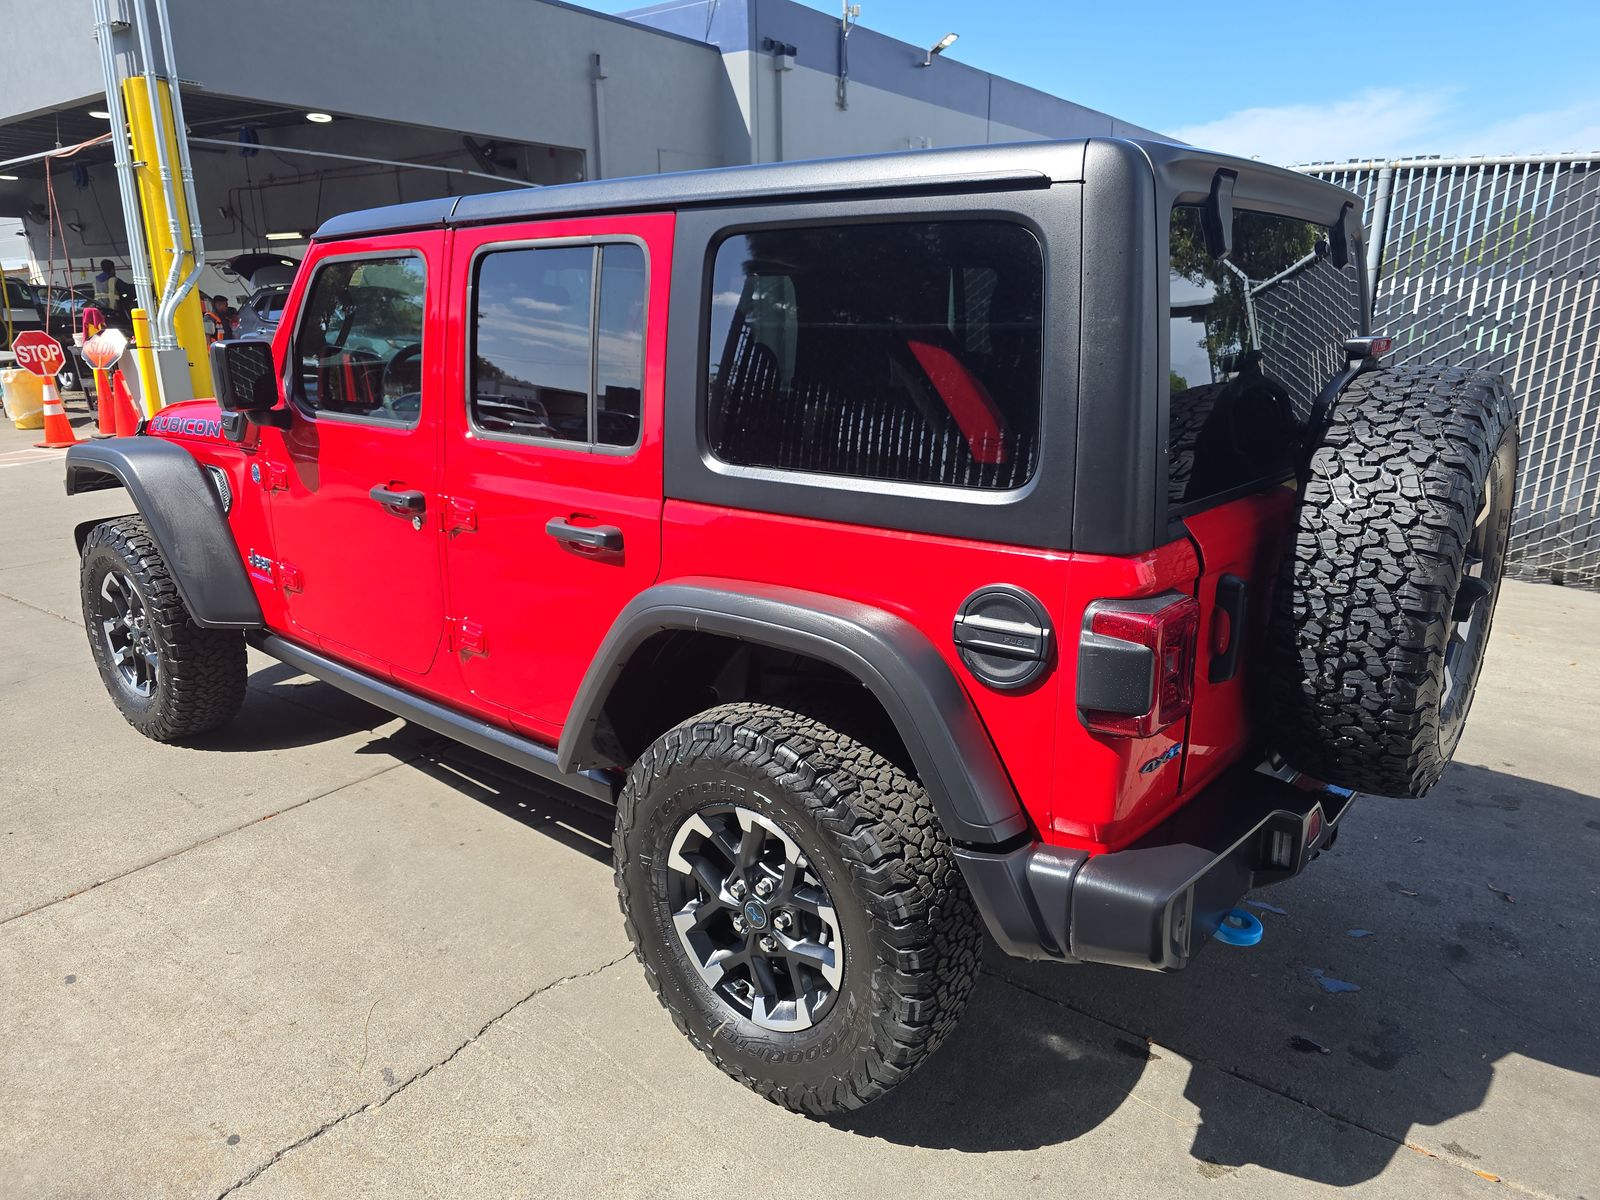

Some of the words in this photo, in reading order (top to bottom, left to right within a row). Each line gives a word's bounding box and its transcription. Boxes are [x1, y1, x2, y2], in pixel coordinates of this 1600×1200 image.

[16, 344, 60, 363] STOP
[151, 416, 221, 438] RUBICON
[248, 548, 273, 576] Jeep
[1002, 636, 1030, 648] FUEL
